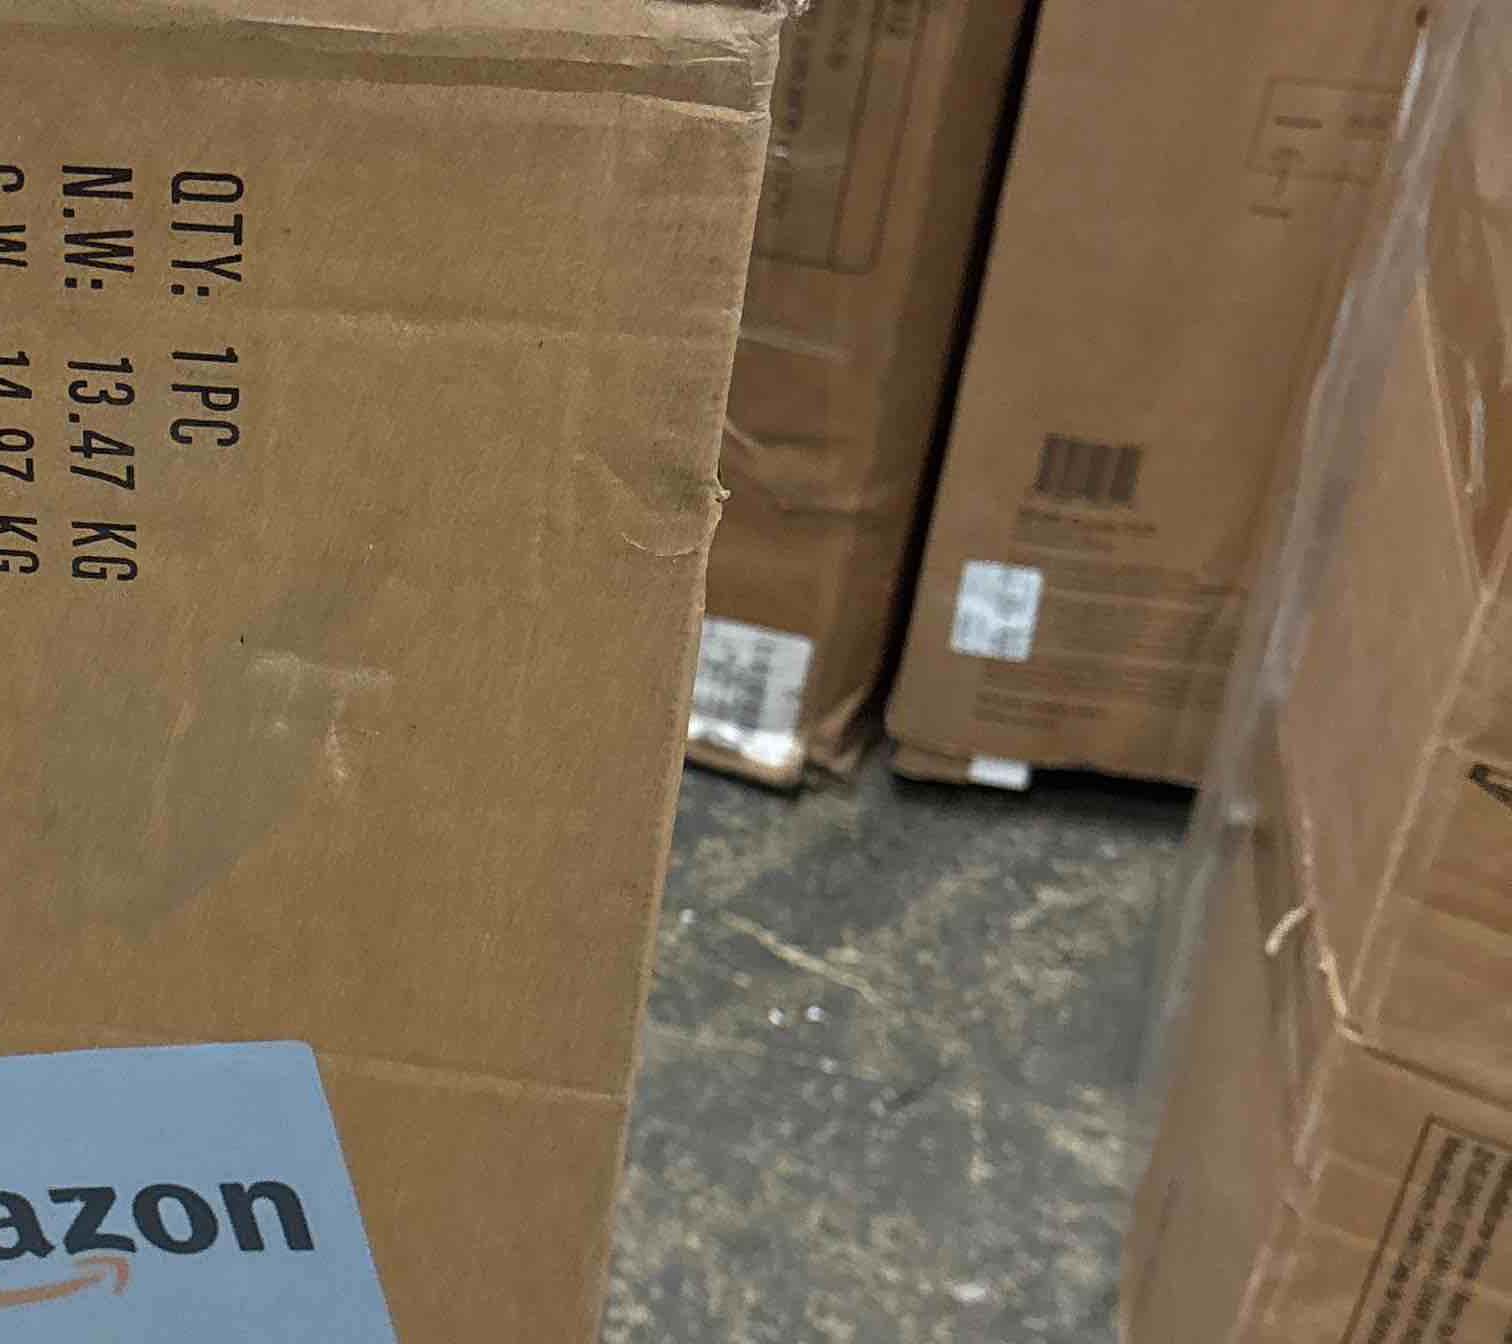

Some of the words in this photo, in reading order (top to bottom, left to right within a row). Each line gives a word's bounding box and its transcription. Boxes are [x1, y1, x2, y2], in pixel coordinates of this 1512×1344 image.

[61, 165, 135, 289] N.W:
[171, 170, 245, 297] QTY:
[68, 357, 136, 491] 13.47
[169, 346, 241, 448] 1PC
[71, 520, 138, 582] KG
